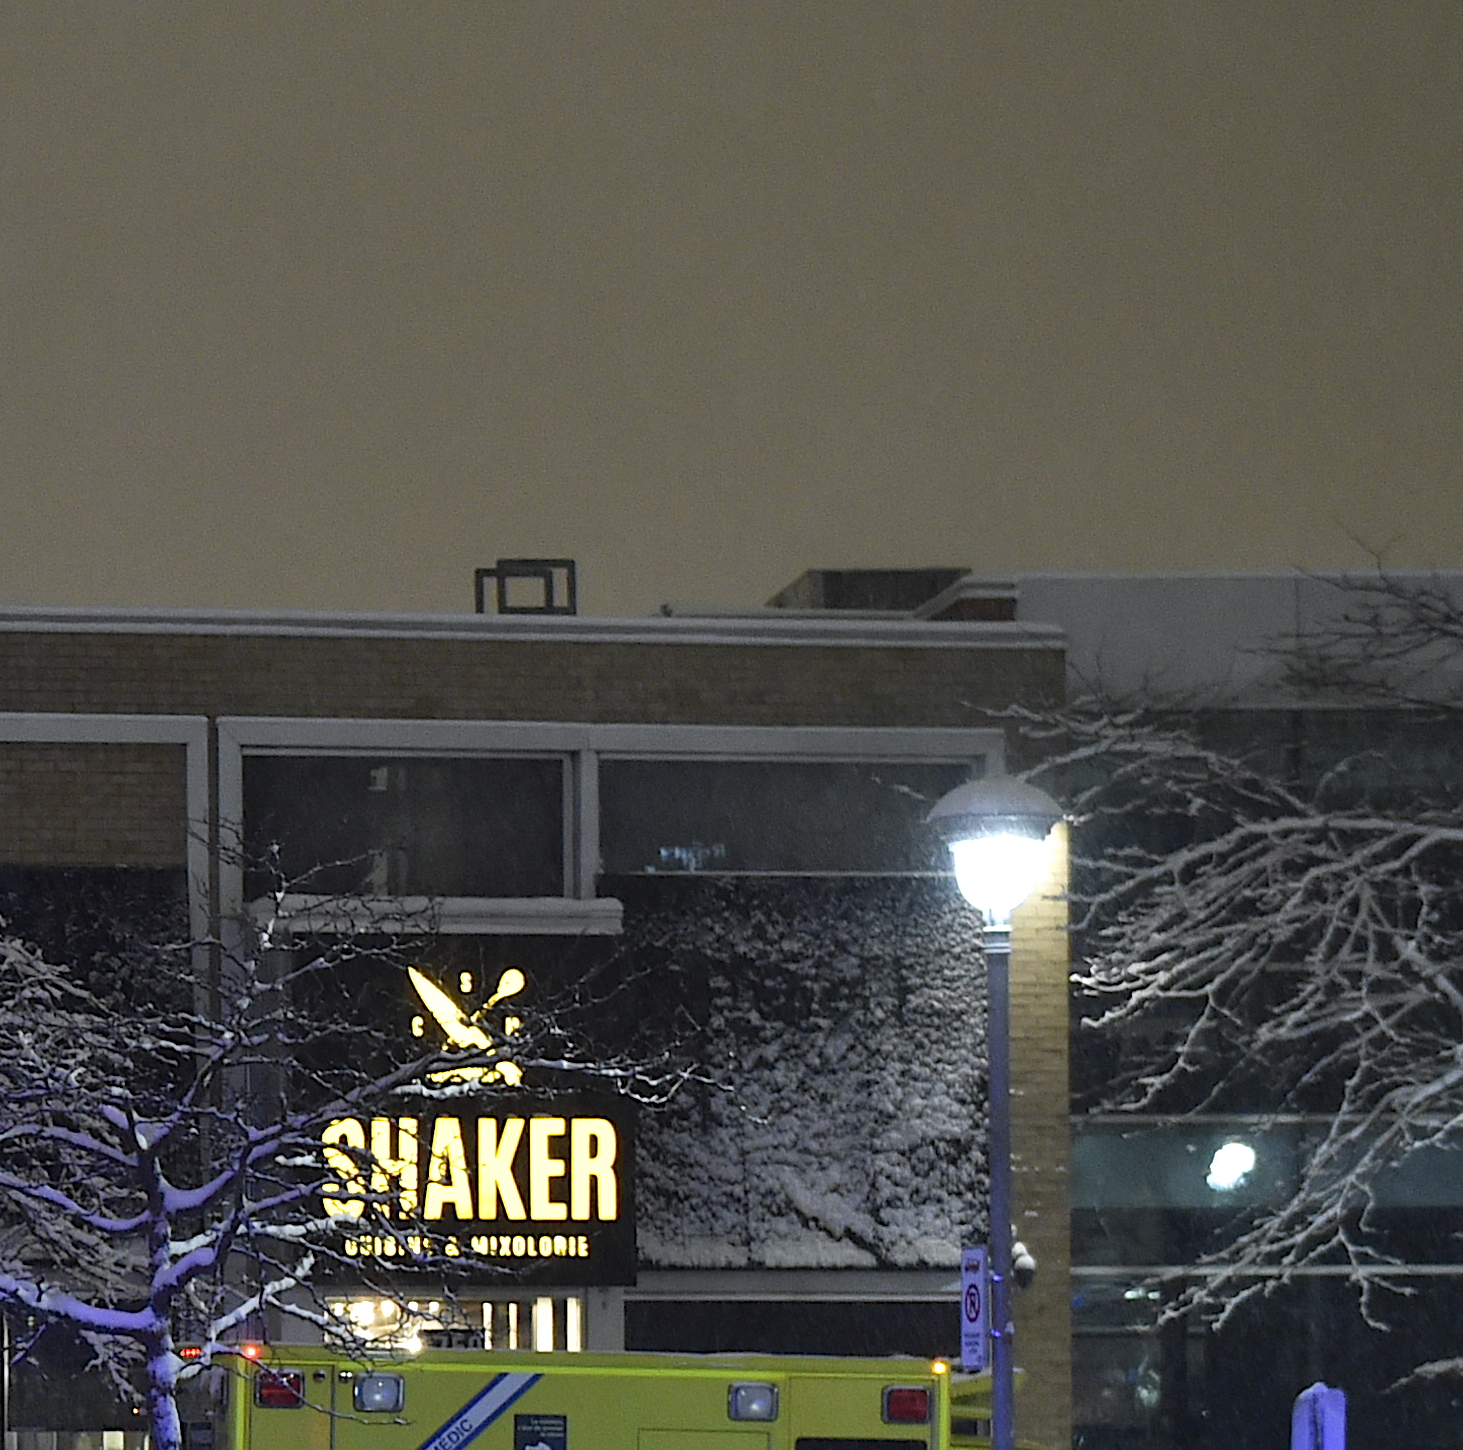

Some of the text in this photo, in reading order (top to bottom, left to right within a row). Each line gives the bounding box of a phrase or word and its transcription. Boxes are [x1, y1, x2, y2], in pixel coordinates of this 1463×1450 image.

[460, 972, 472, 993] S
[411, 1016, 423, 1037] C
[322, 1117, 617, 1221] SHAKER
